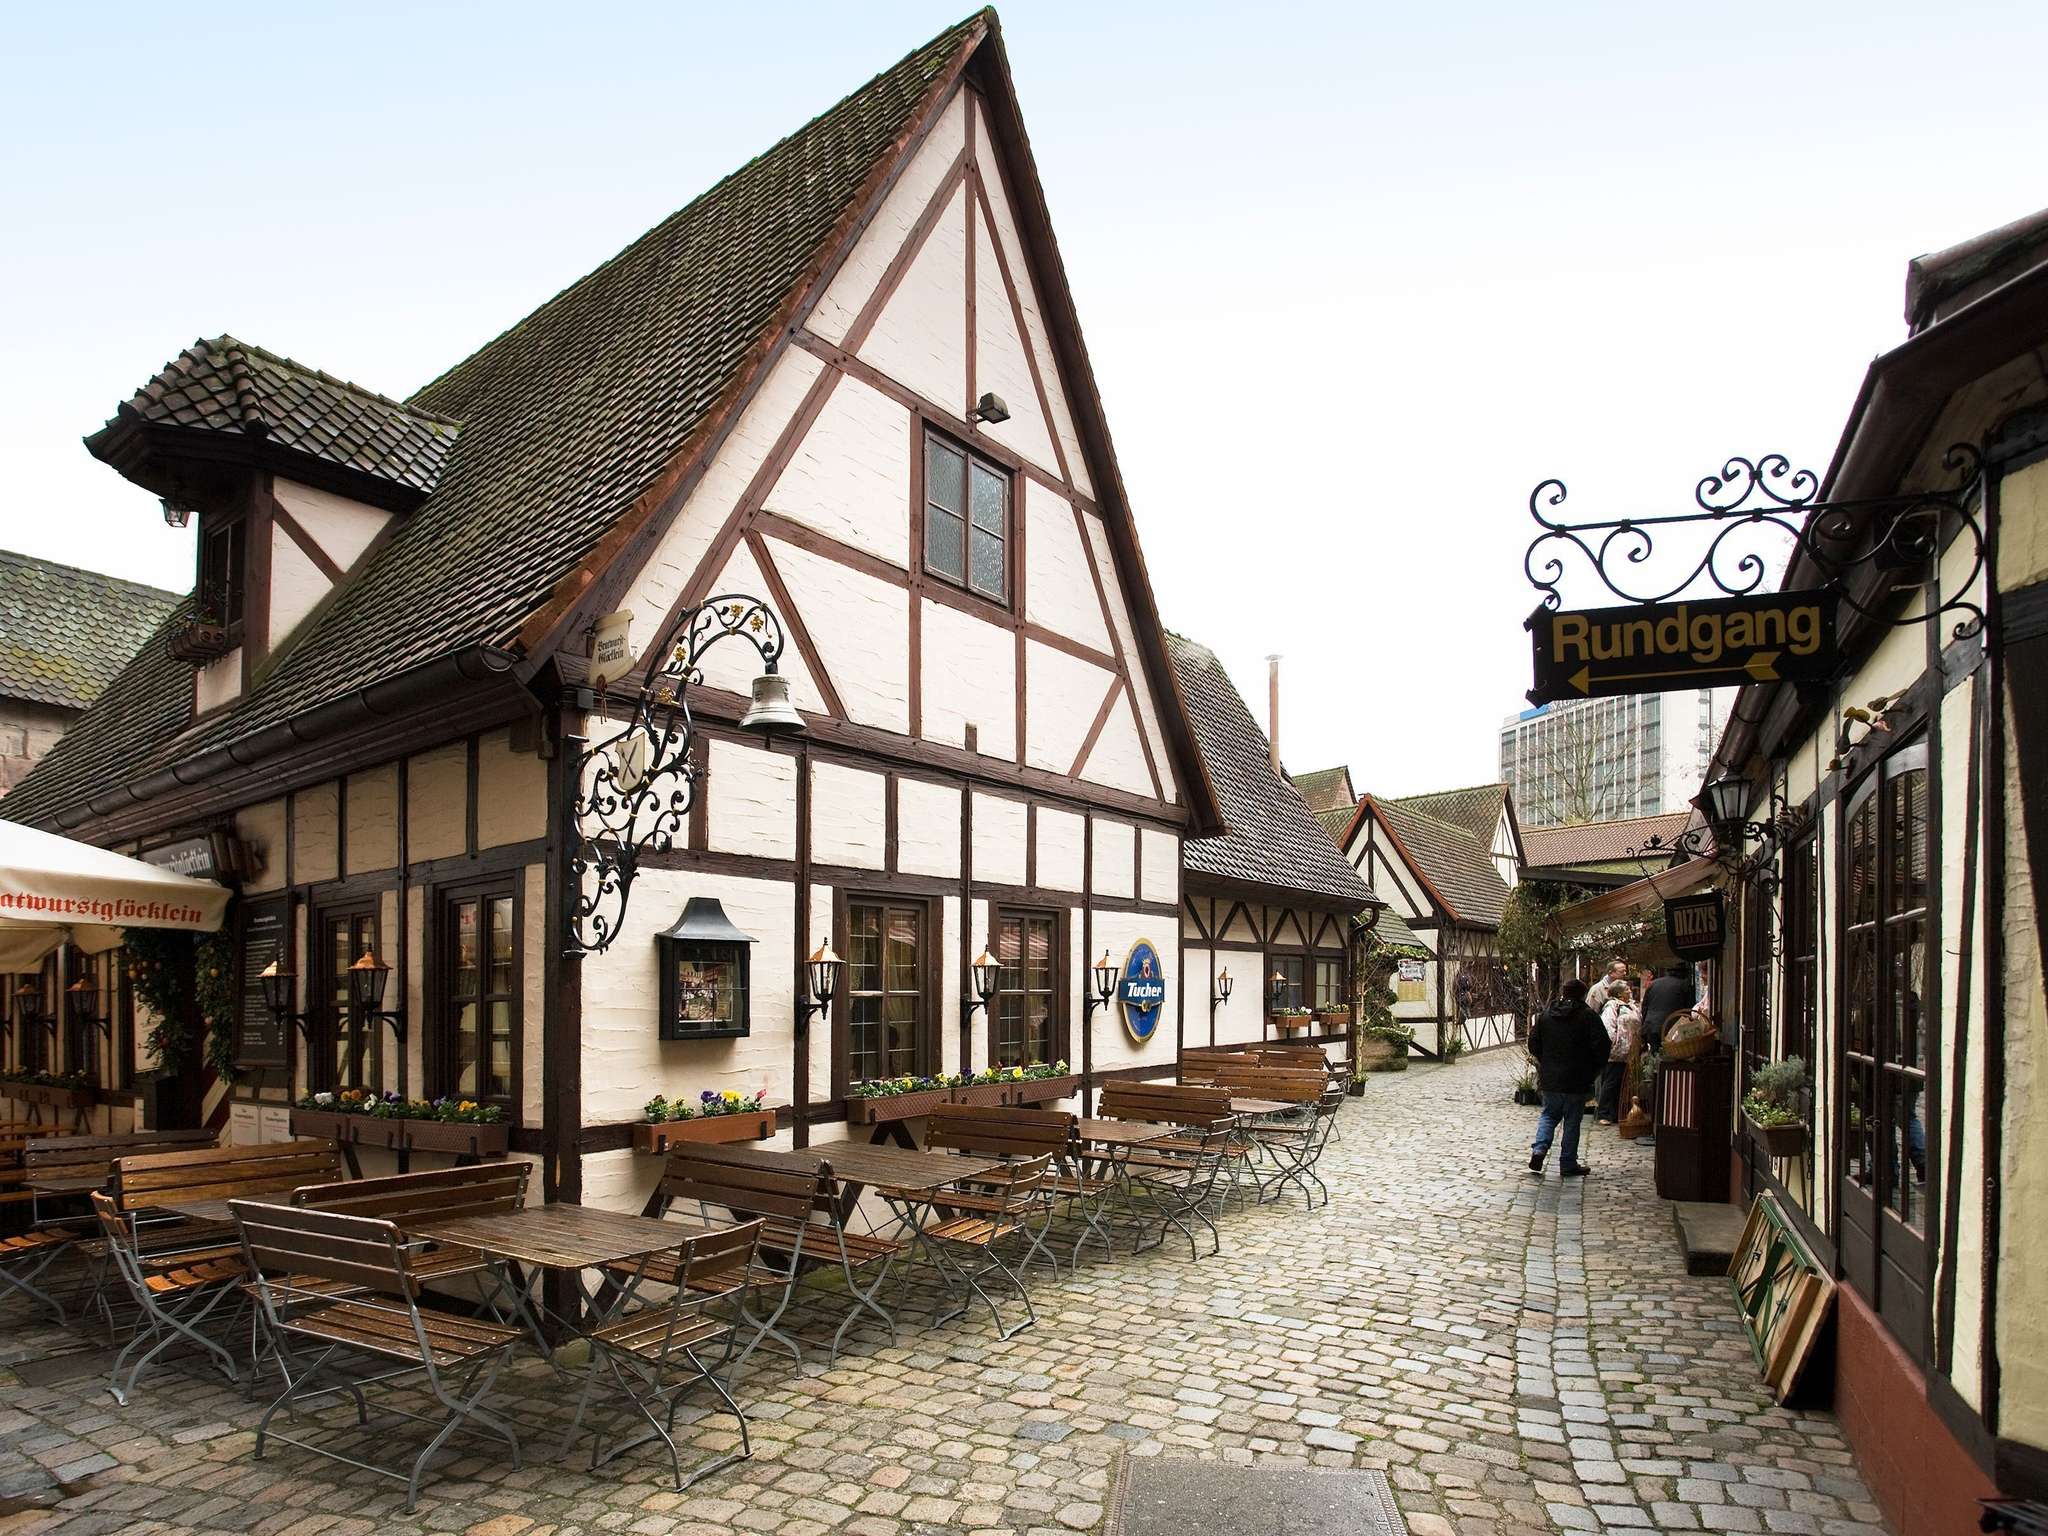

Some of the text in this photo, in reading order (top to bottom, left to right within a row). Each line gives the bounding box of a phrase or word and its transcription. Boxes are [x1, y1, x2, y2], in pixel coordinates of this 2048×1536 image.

[1553, 606, 1821, 663] Rundgang
[1675, 906, 1718, 936] DIZZYS
[1128, 983, 1161, 997] Tucher
